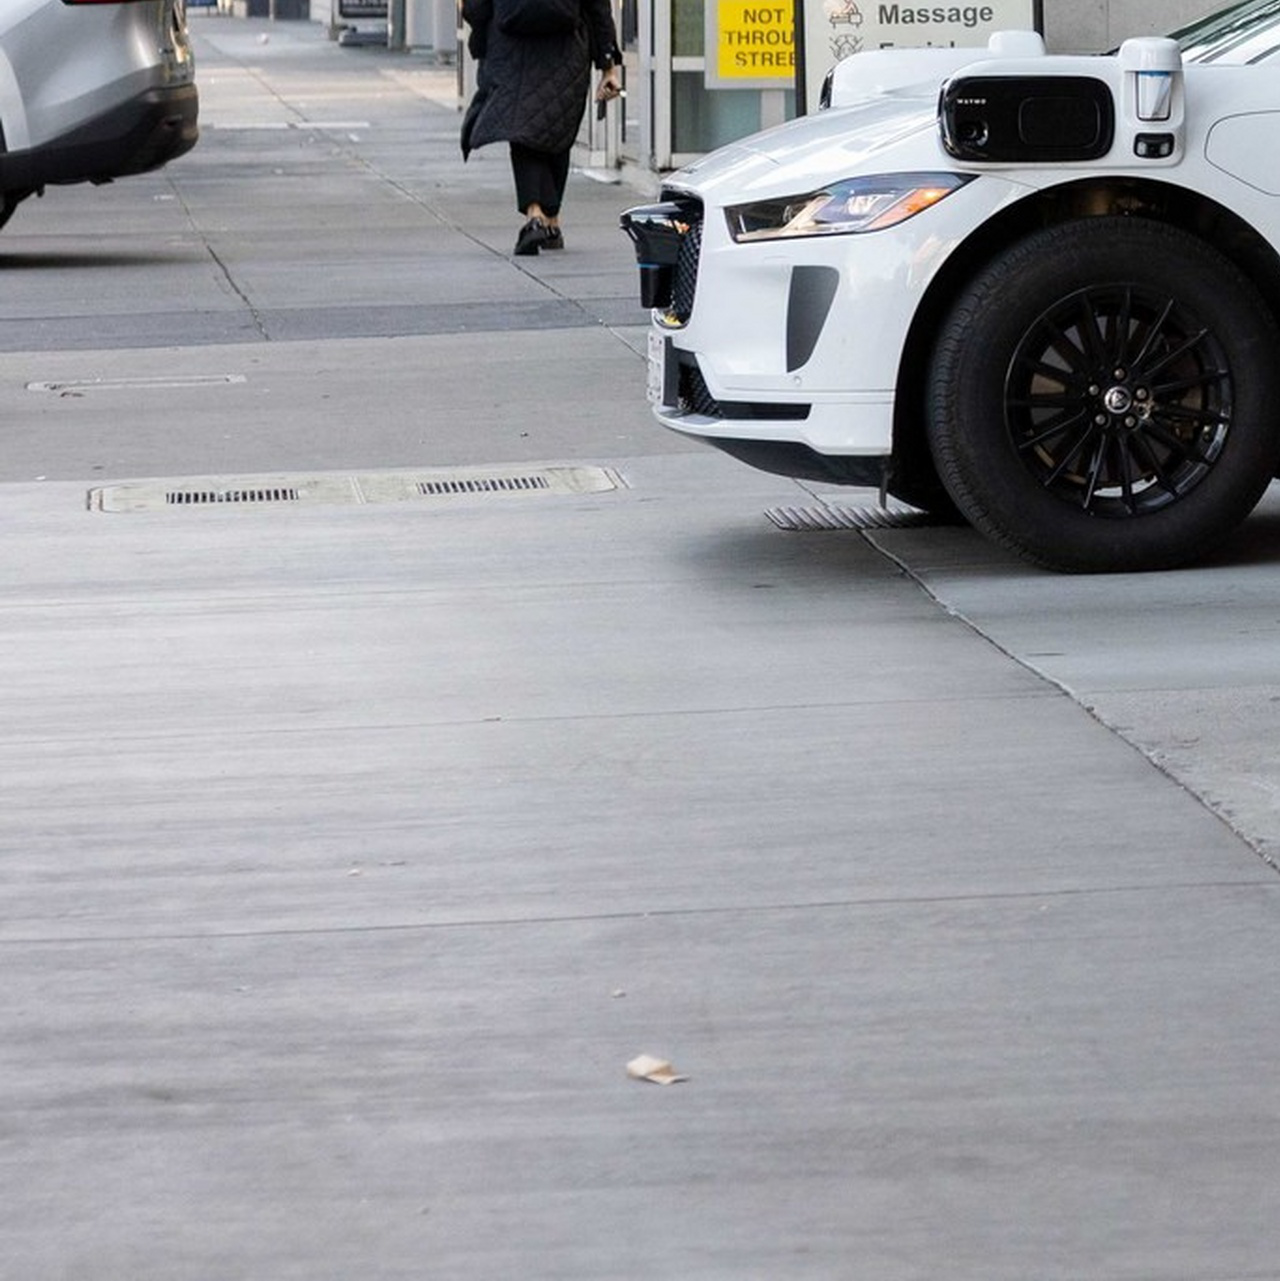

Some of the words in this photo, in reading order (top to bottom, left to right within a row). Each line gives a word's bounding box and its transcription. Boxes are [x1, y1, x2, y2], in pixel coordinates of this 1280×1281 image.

[743, 8, 786, 25] NOT
[878, 3, 994, 28] Massage
[723, 29, 795, 46] THROU
[735, 51, 795, 67] STREE
